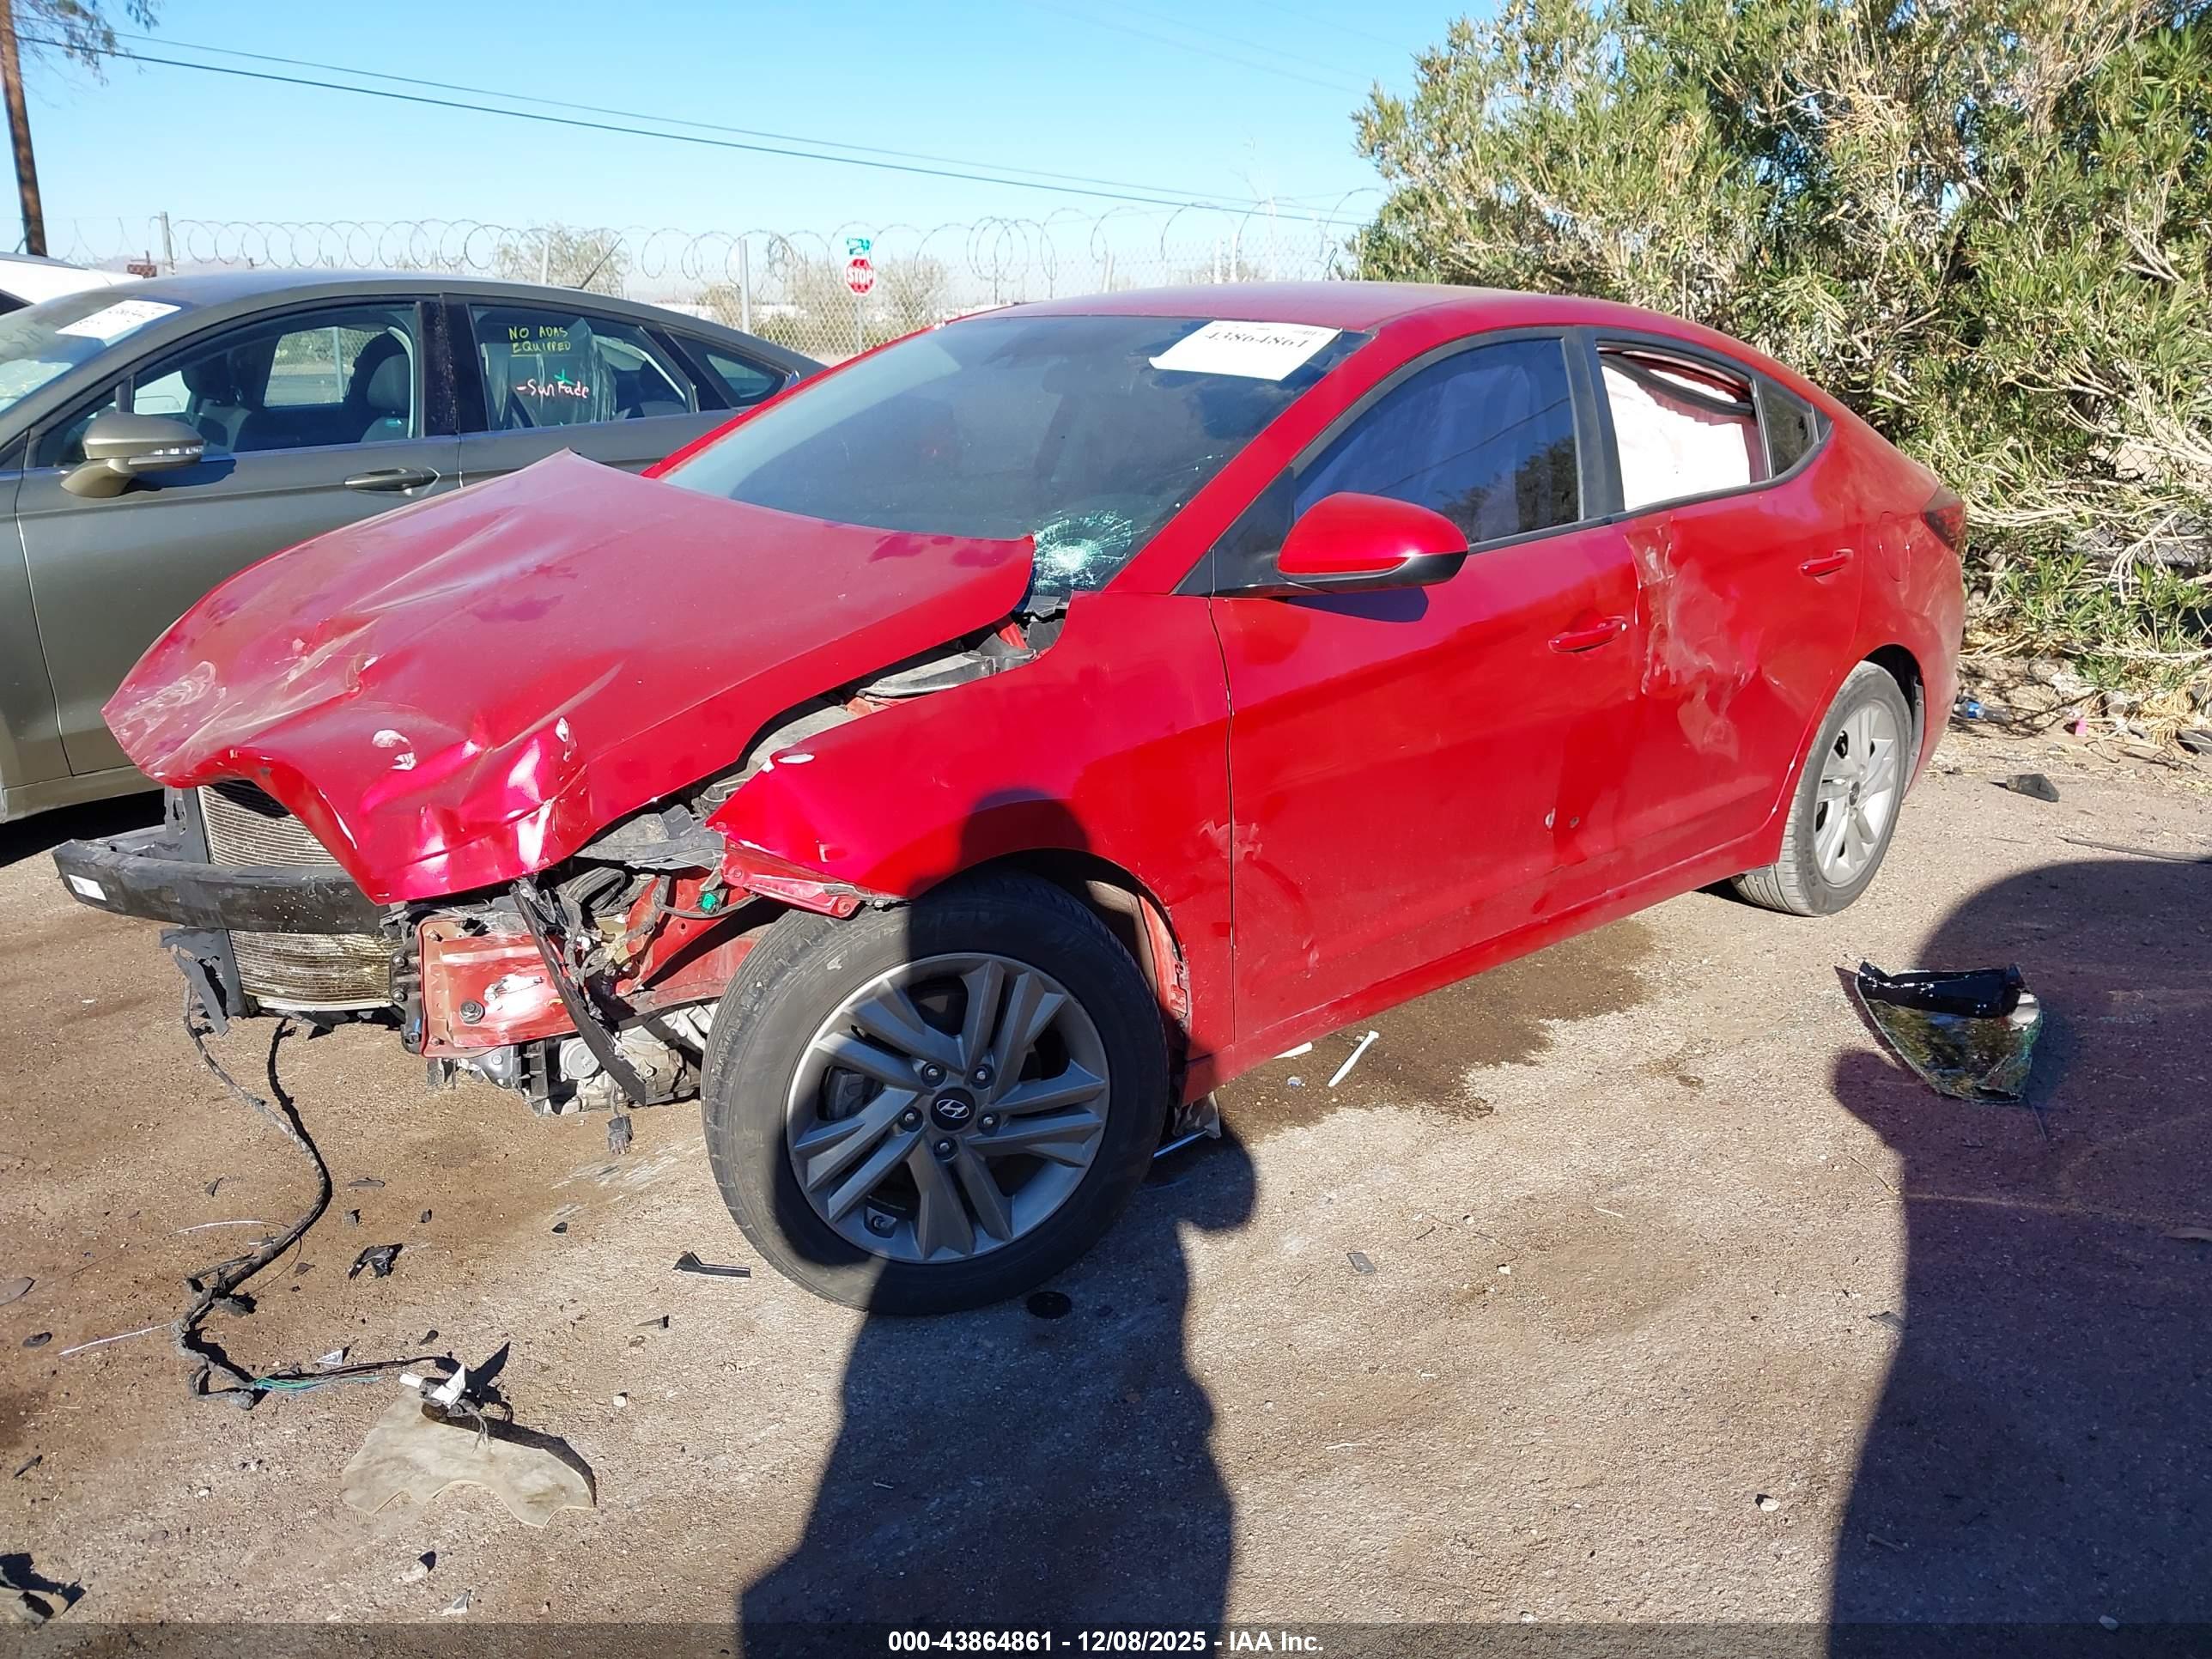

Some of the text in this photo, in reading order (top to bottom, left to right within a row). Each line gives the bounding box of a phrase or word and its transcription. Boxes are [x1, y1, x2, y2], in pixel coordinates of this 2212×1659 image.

[847, 266, 873, 284] STOP
[508, 325, 568, 340] NO ADAS
[512, 341, 571, 353] EQUIPPED
